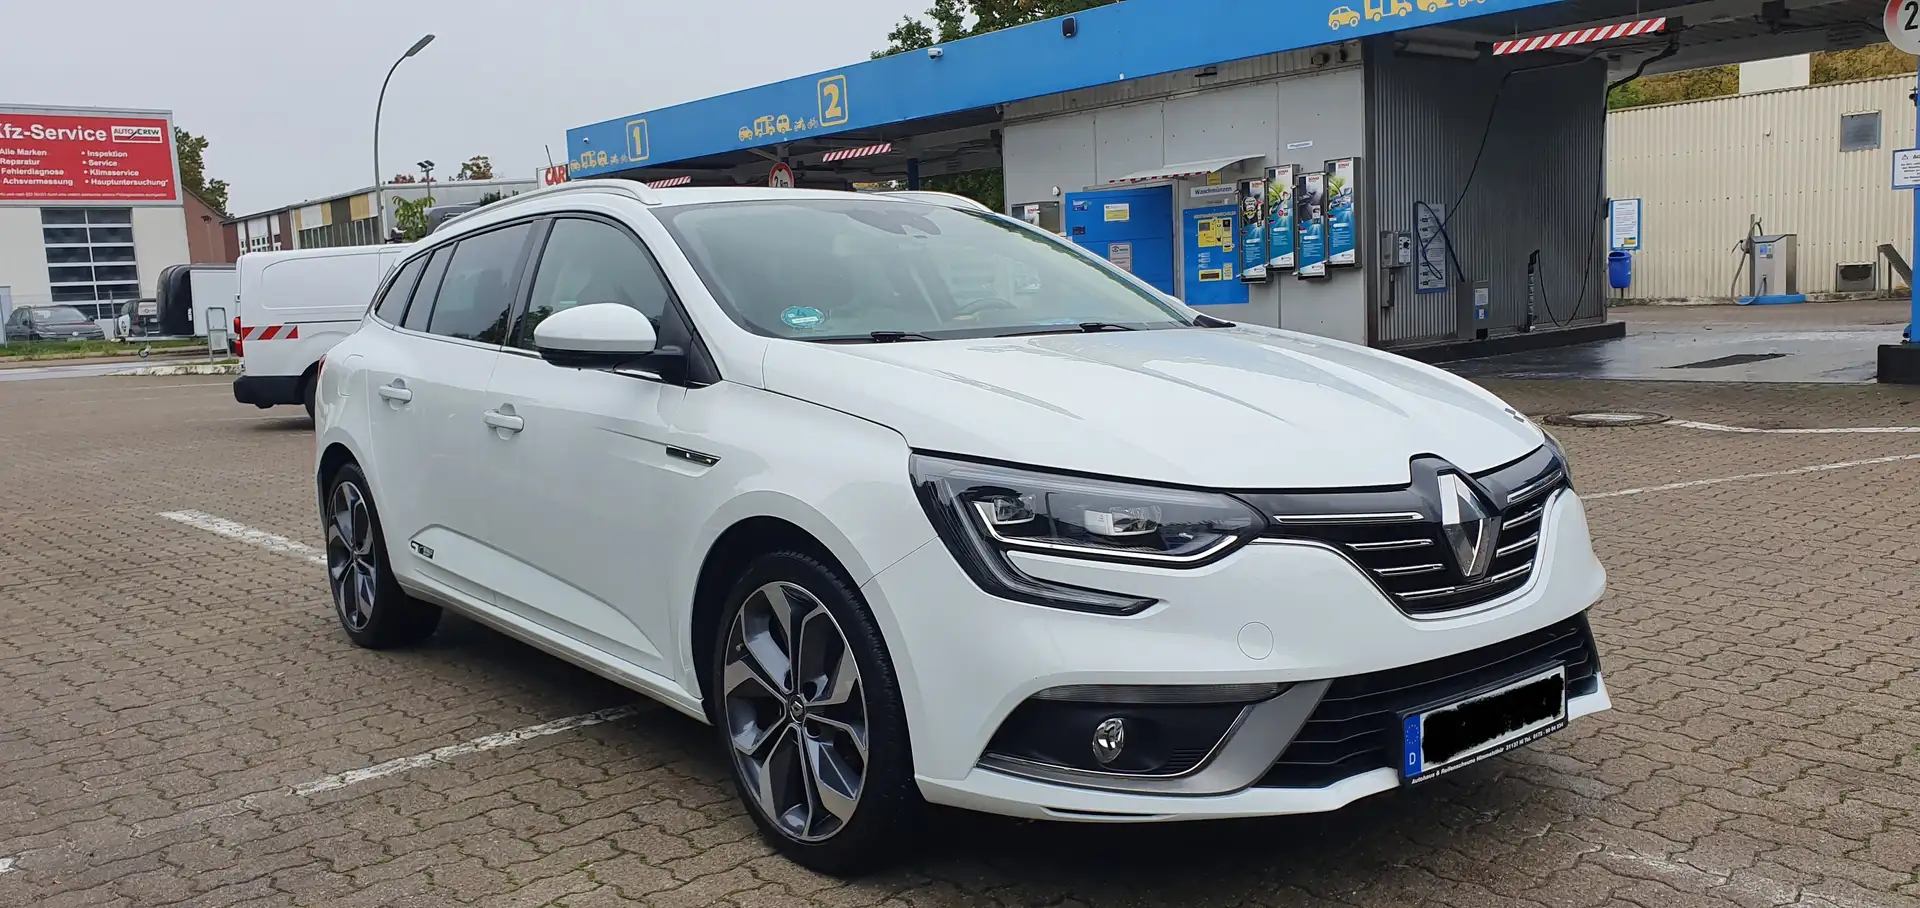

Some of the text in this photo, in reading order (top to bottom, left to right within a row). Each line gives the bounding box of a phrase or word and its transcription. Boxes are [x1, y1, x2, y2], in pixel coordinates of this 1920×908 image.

[823, 83, 842, 119] 2
[113, 127, 160, 136] AUTO CREW
[633, 126, 642, 156] 1
[17, 148, 48, 156] Marken
[87, 150, 128, 158] Inspektion
[0, 158, 41, 166] Reparatur
[88, 159, 118, 167] Service
[1, 167, 65, 176] Fehlerdiagnose
[89, 168, 140, 176] Klimaservice
[3, 177, 74, 186] Achsvermessung
[1195, 186, 1233, 195] Waschmünzen
[1409, 752, 1416, 766] D
[1411, 772, 1436, 785] Autohaus
